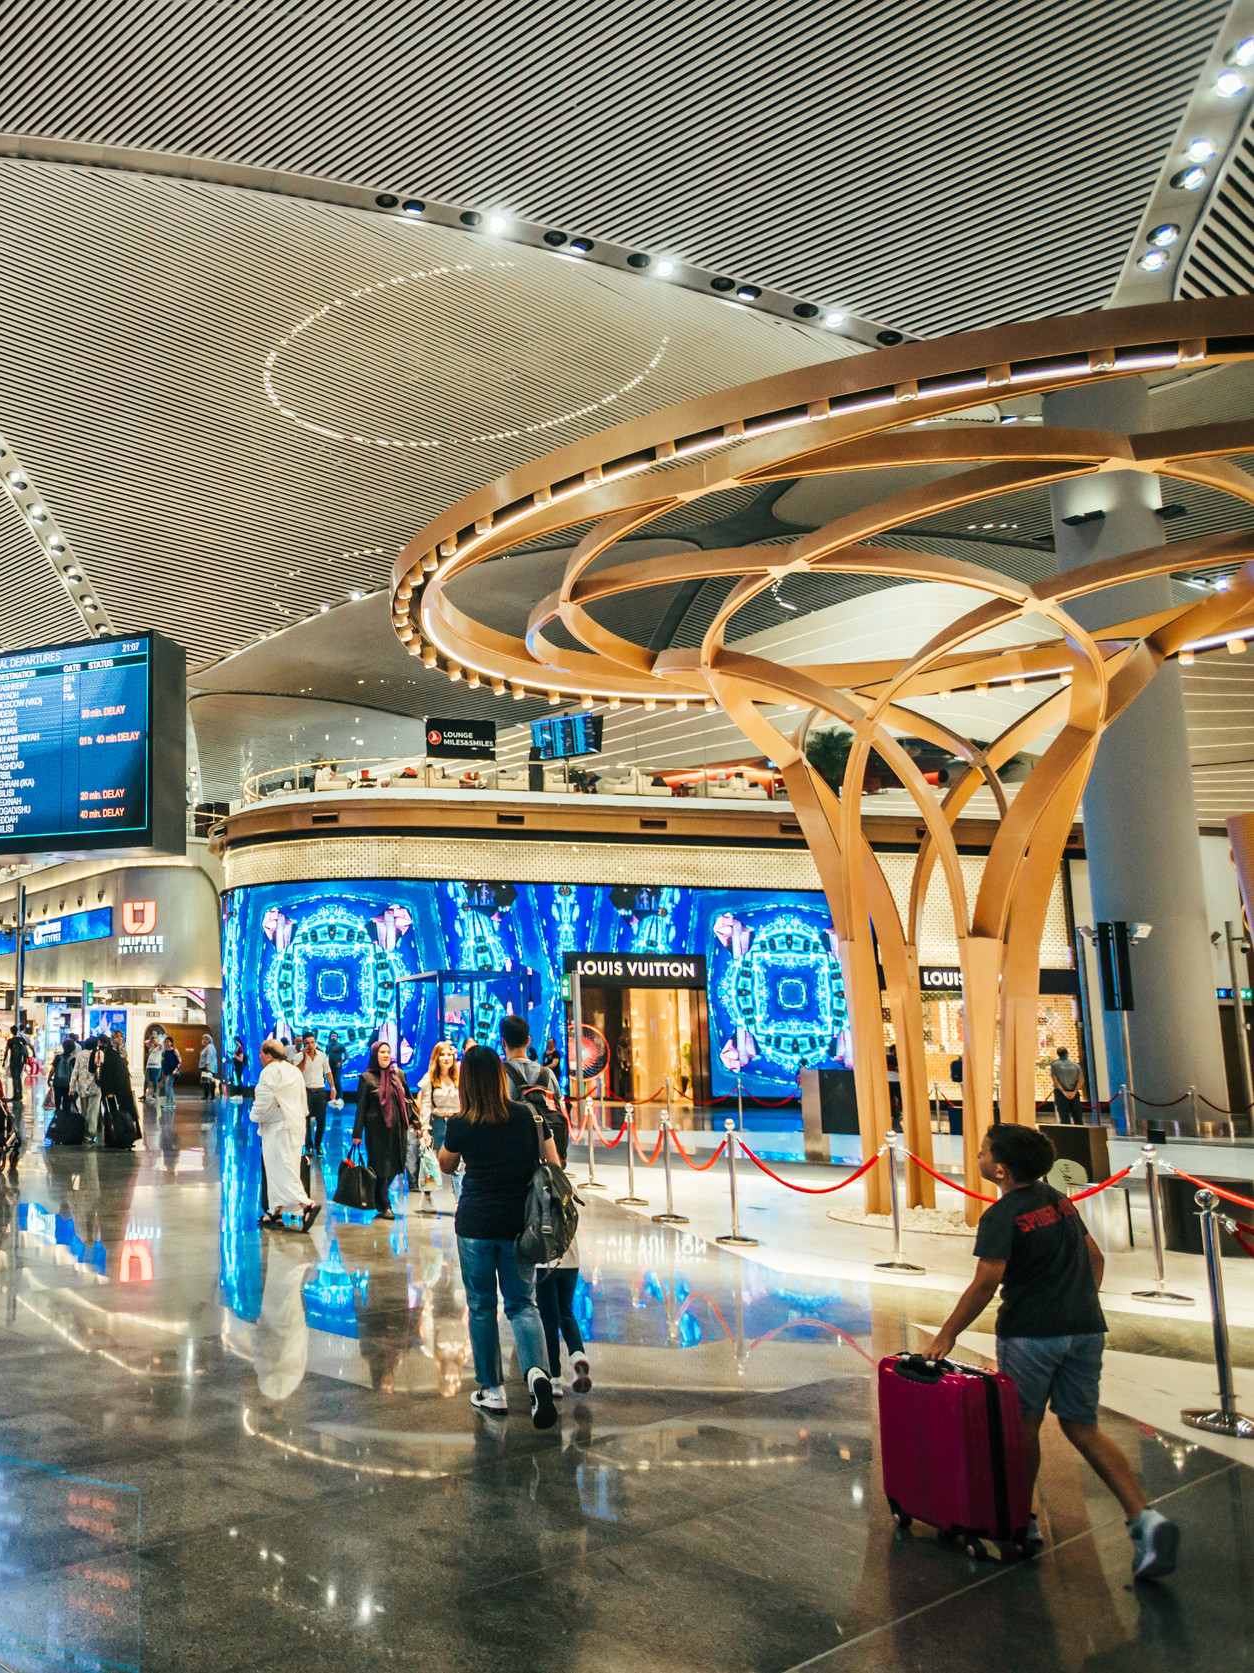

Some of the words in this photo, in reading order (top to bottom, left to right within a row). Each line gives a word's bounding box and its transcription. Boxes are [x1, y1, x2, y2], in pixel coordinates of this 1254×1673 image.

[10, 652, 60, 667] DEPARTURES
[122, 642, 139, 652] 21:07
[63, 663, 80, 672] GATE
[88, 659, 113, 669] STATUS
[103, 705, 125, 715] DELAY
[117, 731, 139, 741] DELAY
[443, 731, 474, 739] LOUNGE
[443, 739, 494, 747] MILES&SMILES
[102, 789, 124, 798] DELAY
[102, 807, 124, 817] DELAY
[118, 936, 164, 946] UNIFREE
[118, 945, 164, 954] DUTYFREE
[577, 960, 623, 976] LOUIS
[627, 961, 696, 977] VUITTON
